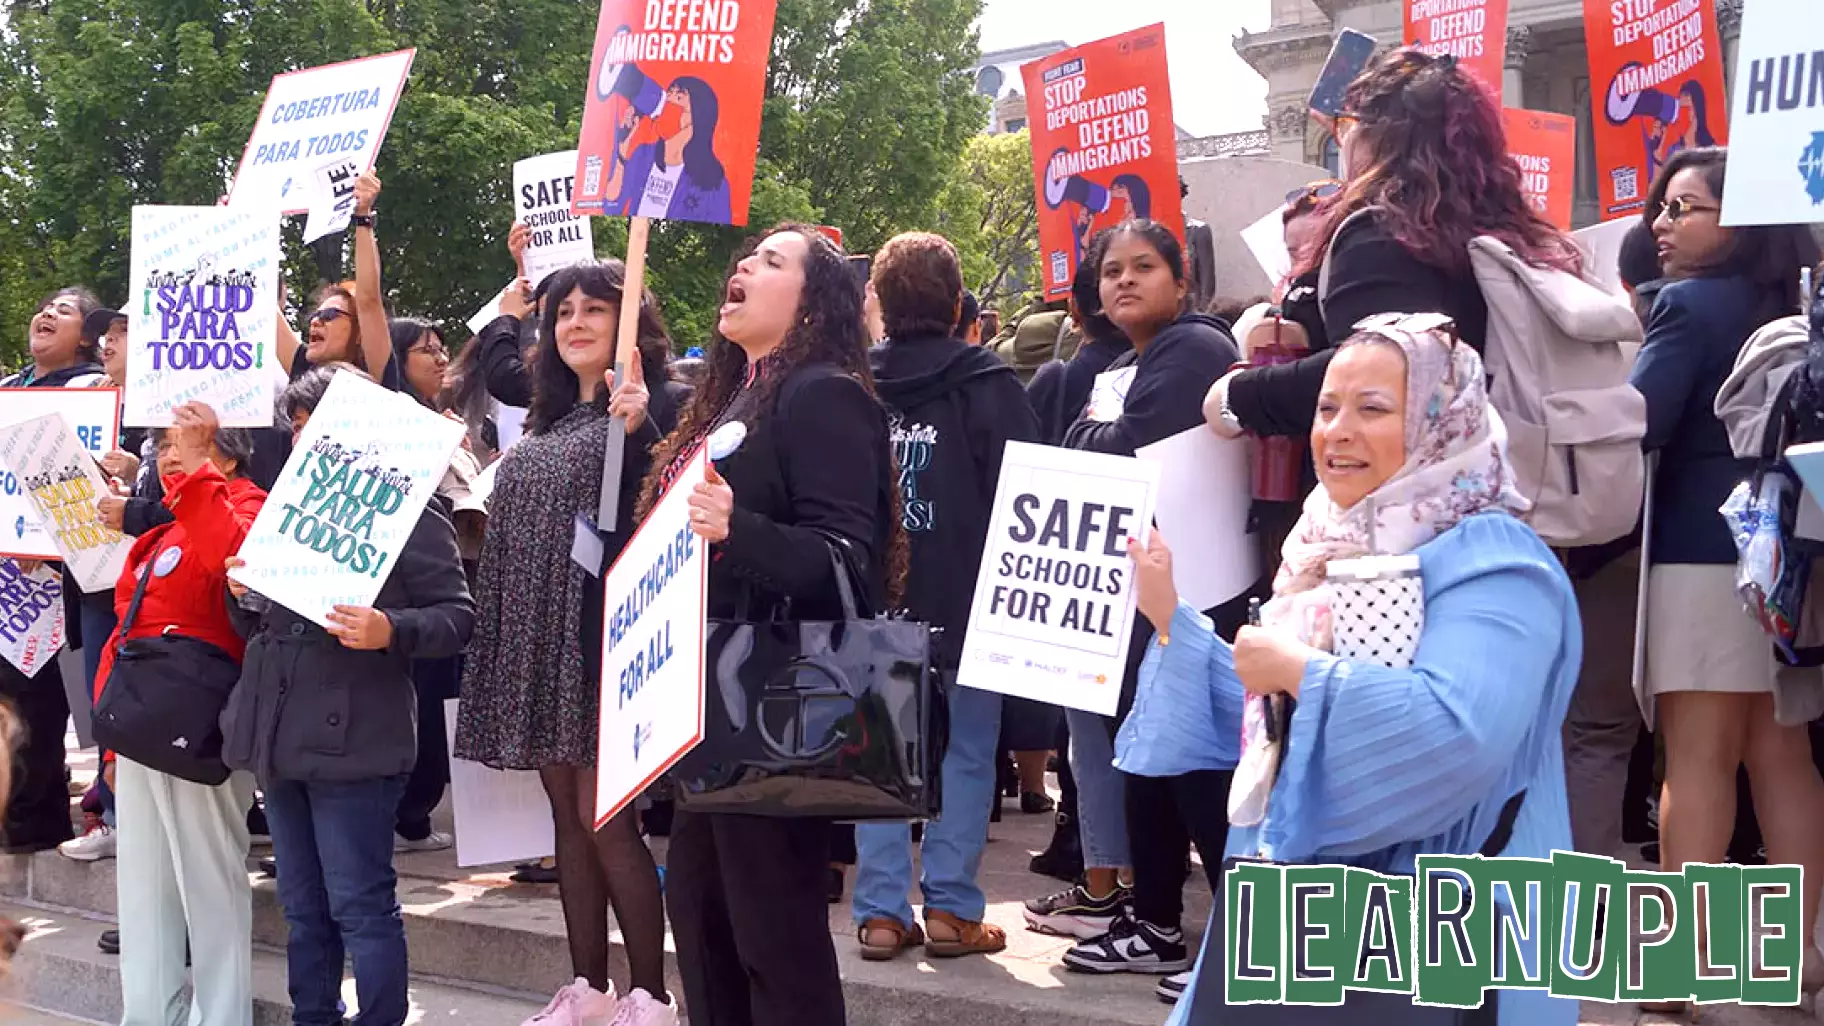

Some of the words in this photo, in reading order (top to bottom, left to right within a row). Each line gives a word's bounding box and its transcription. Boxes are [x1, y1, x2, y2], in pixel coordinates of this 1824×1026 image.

[643, 0, 740, 32] DEFEND
[1430, 8, 1486, 41] DEFEND
[1652, 11, 1703, 60] DEFEND
[607, 33, 736, 63] IMMIGRANTS
[1615, 38, 1705, 96] IMMIGRANTS
[271, 86, 381, 125] COBERTURA
[1043, 76, 1086, 110] STOP
[1046, 86, 1147, 131] DEPORTATIONS
[252, 139, 301, 166] PARA
[305, 129, 369, 158] TODOS
[1078, 109, 1150, 149] DEFEND
[1050, 134, 1152, 179] IMMIGRANTS
[558, 225, 584, 244] ALL
[161, 311, 240, 340] PARA
[146, 341, 264, 370] TODOS!
[300, 482, 376, 540] PARA
[1008, 492, 1134, 558] SAFE
[278, 503, 388, 579] TODOS!
[608, 520, 695, 653] HEALTHCARE
[998, 551, 1124, 596] SCHOOLS
[989, 584, 1052, 625] FOR
[1059, 597, 1114, 638] ALL
[618, 648, 645, 711] FOR
[646, 619, 674, 676] ALL
